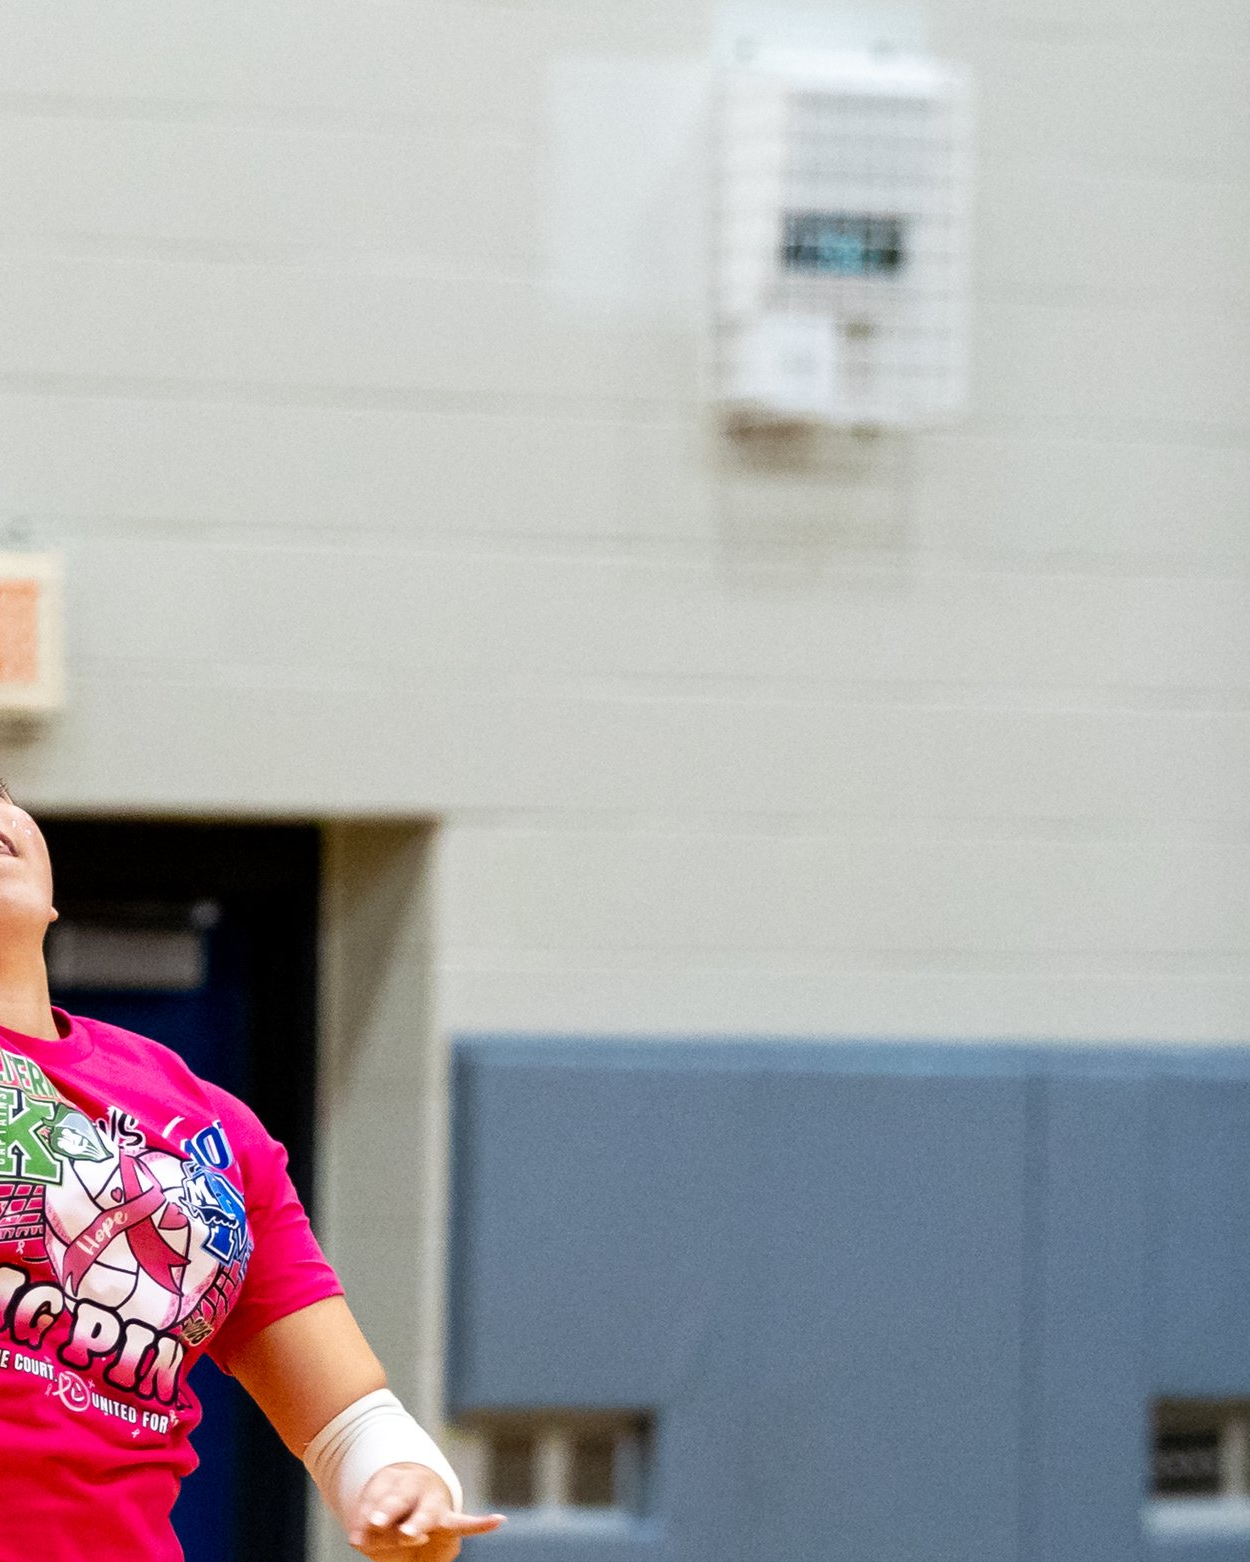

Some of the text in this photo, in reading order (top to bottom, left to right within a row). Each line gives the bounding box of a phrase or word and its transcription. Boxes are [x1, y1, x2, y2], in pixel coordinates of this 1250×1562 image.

[76, 1211, 128, 1255] Hope
[57, 1298, 184, 1406] PIN
[14, 1353, 59, 1382] COURT.
[91, 1393, 138, 1424] UNITED
[142, 1411, 169, 1434] FOR
